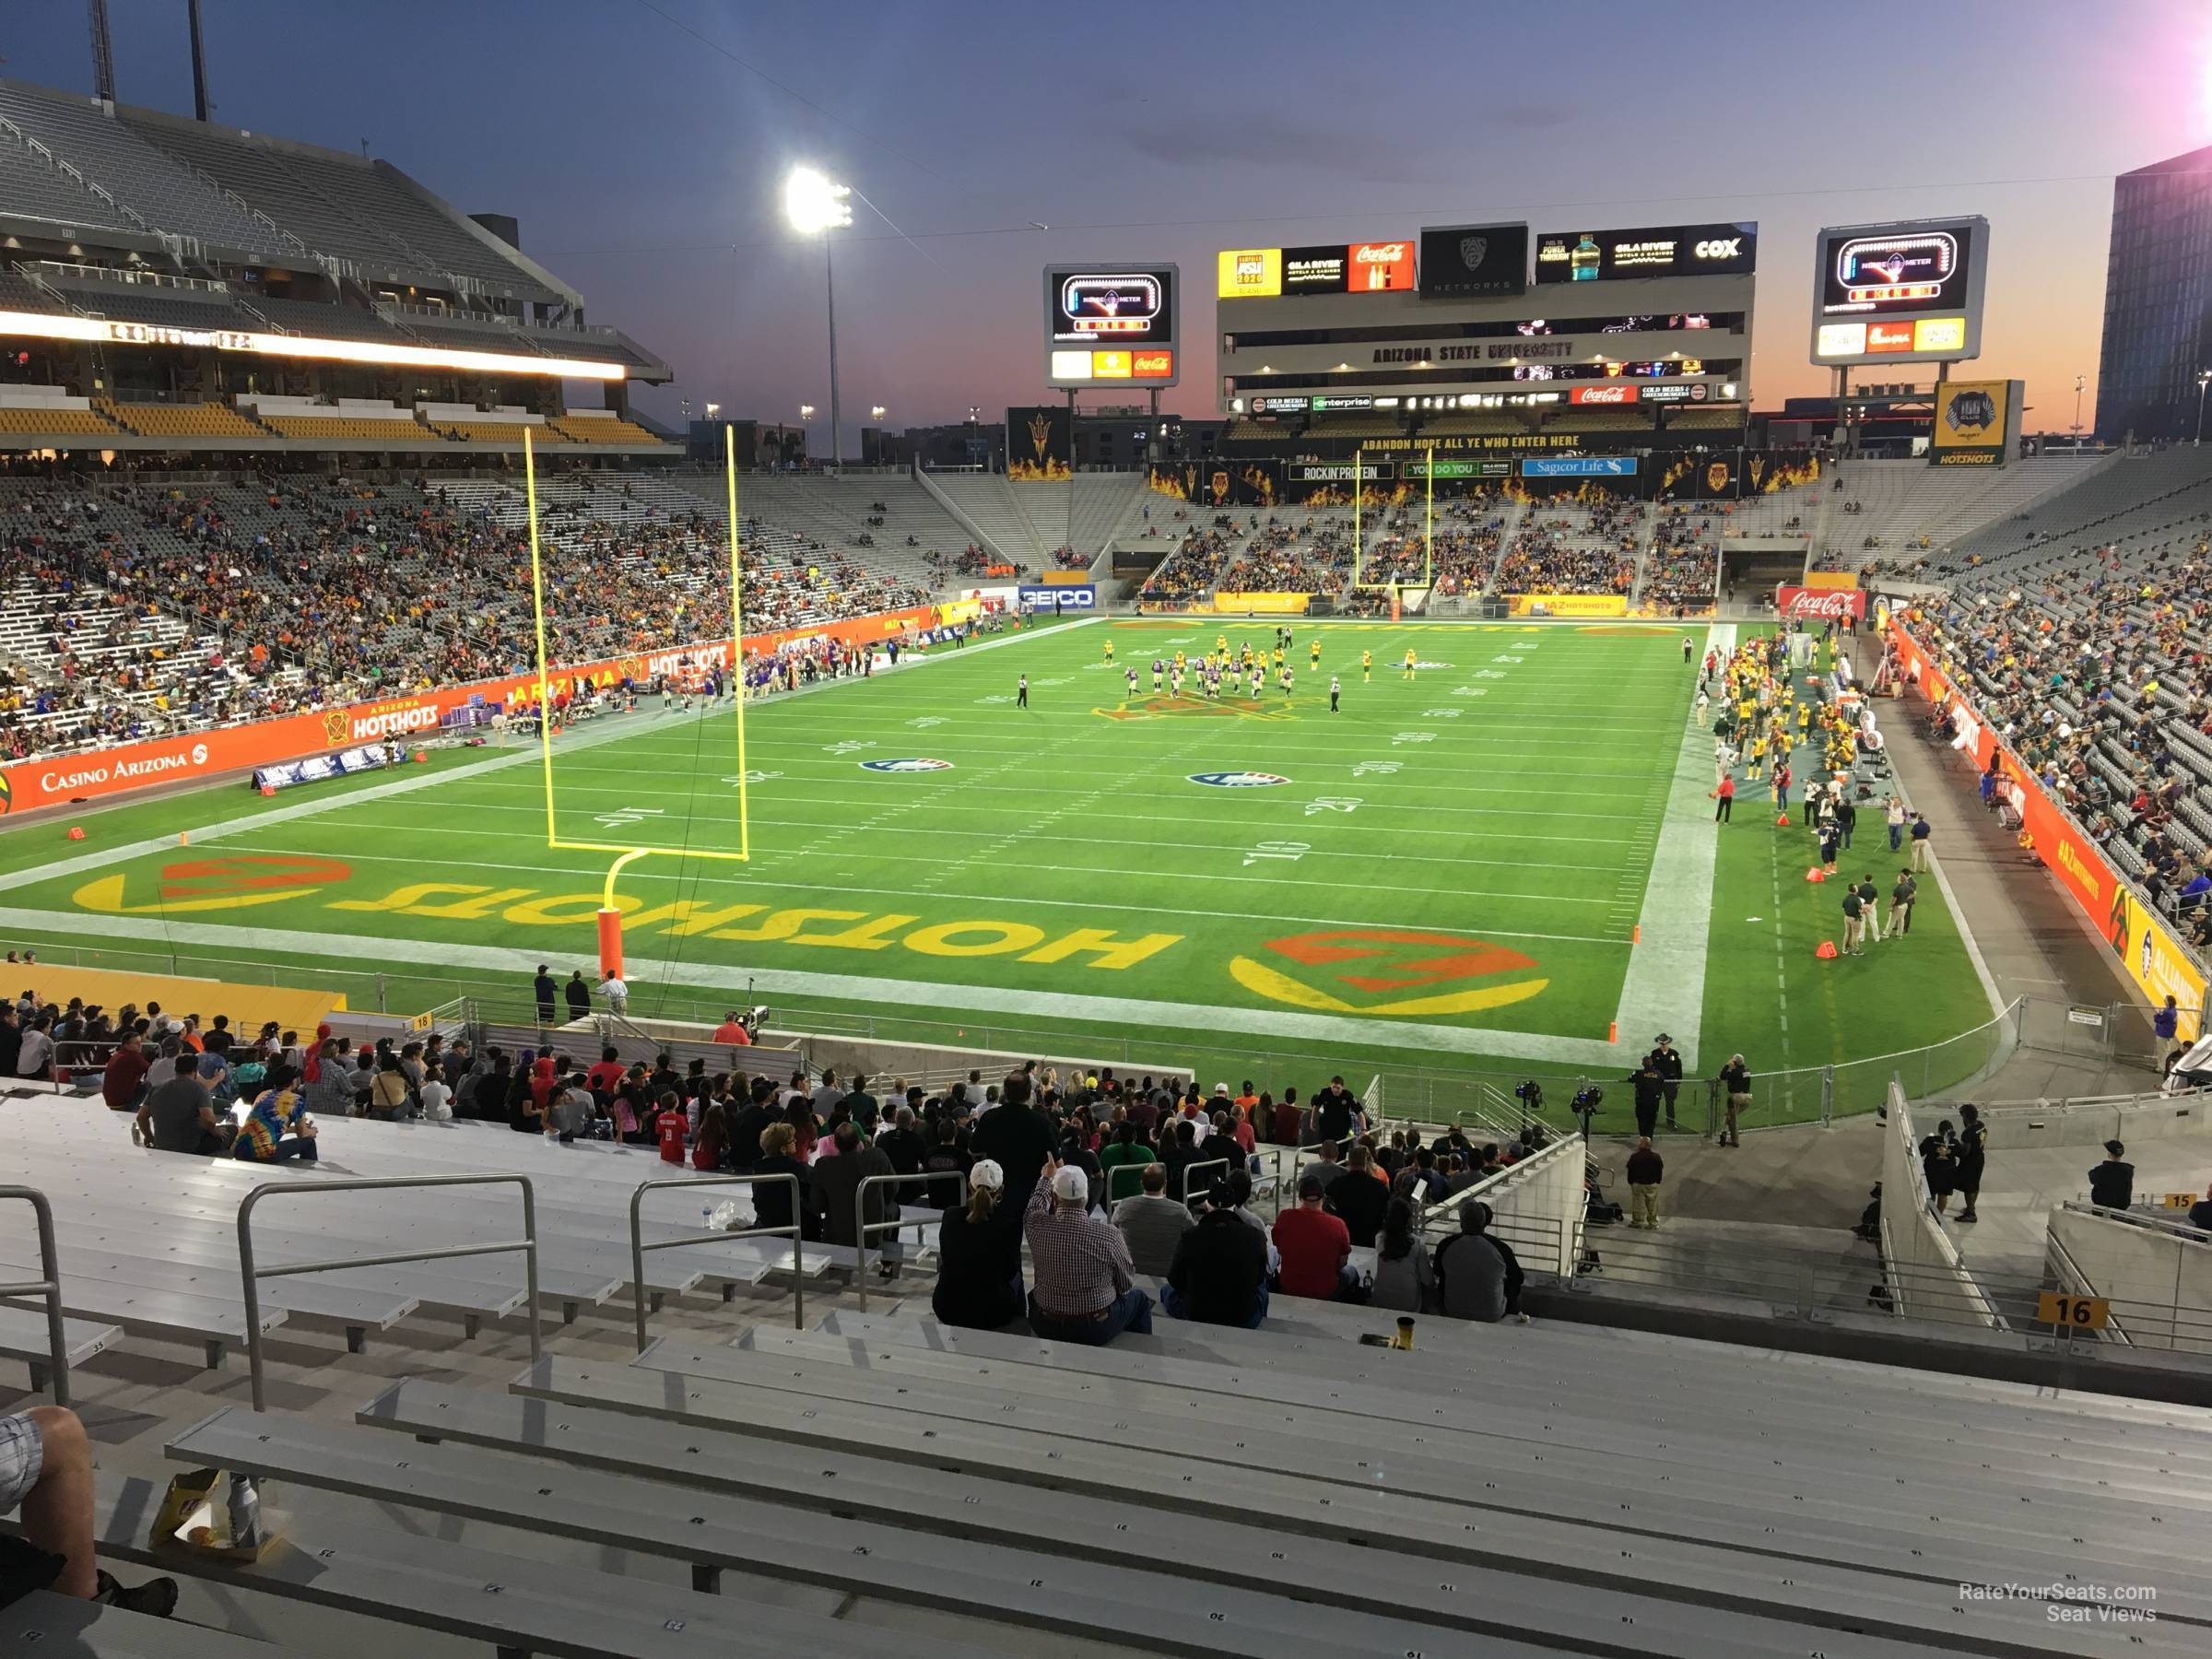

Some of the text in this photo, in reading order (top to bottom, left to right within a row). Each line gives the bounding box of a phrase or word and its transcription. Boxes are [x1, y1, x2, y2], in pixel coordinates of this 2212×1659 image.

[1357, 244, 1406, 263] Coca-Cola
[1543, 245, 1566, 253] POWER
[1616, 241, 1674, 253] GILA RIVER
[1695, 237, 1741, 259] COX
[1238, 262, 1262, 276] ASU
[1288, 259, 1341, 270] GILA RIVER
[1238, 275, 1262, 283] 2020
[1434, 281, 1511, 291] NETWORKS
[1372, 347, 1432, 363] ARIZONA
[1440, 345, 1480, 360] STATE
[1135, 357, 1169, 371] Coca-Cola
[1316, 397, 1371, 407] enterprise
[1582, 387, 1627, 403] Coca-Cola
[1361, 435, 1579, 451] ABANDON HOPE ALL YE WHO ENTER HERE
[1536, 459, 1604, 474] Sagicor Life
[1940, 454, 1996, 465] HOTSHOTS
[1435, 464, 1451, 474] DO
[1452, 464, 1474, 474] YOU
[1022, 590, 1094, 606] GEICO
[1790, 591, 1858, 616] Coca-Cola
[371, 700, 420, 714] ARIZONA
[353, 704, 439, 739] HOTSHOTS
[41, 754, 188, 792] CASINO ARIZONA
[323, 882, 1185, 971] HOTSHOTS
[418, 1017, 429, 1029] 18
[2173, 1194, 2189, 1207] 15
[2056, 1298, 2091, 1324] 16
